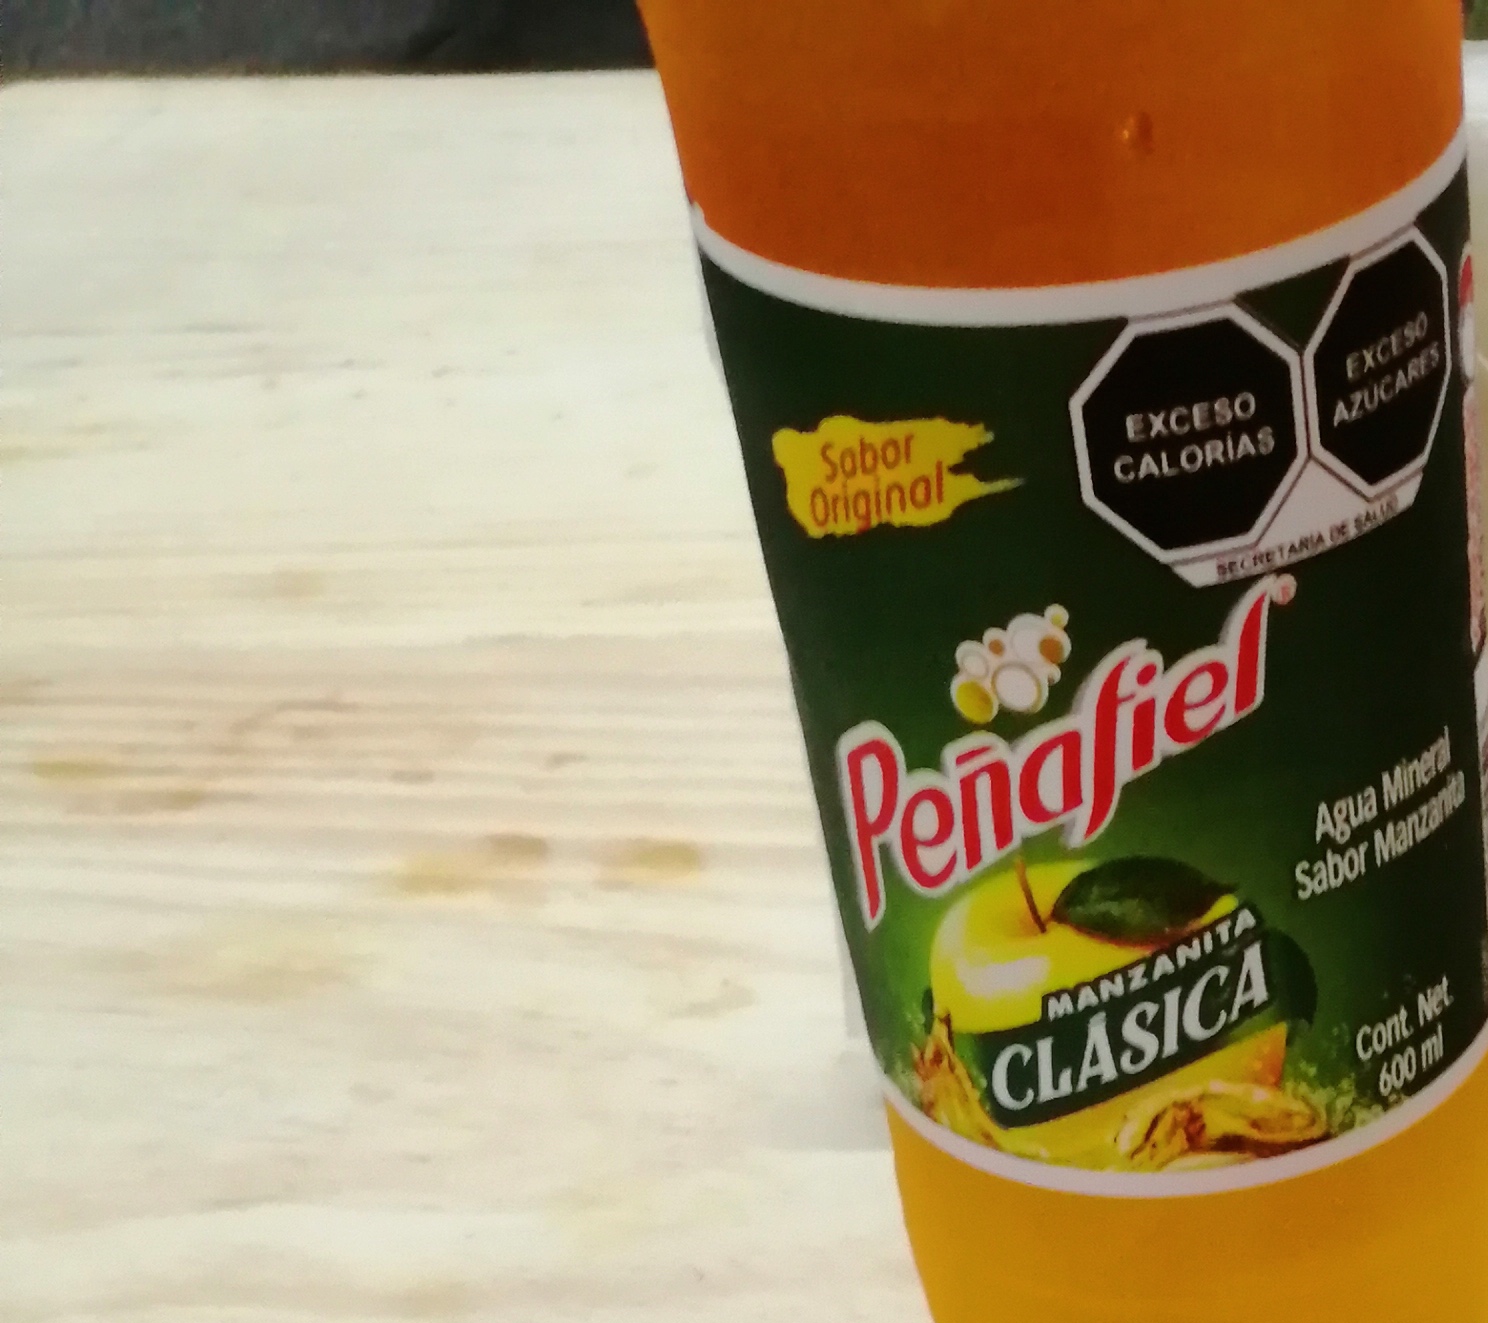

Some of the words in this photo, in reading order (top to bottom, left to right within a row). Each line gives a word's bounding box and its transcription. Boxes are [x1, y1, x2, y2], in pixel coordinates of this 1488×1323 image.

[1346, 311, 1428, 379] EXCESO
[1126, 391, 1257, 442] EXCESO
[820, 433, 914, 484] Sabor
[810, 459, 944, 534] Original
[840, 578, 1269, 926] Peñafiel
[1316, 785, 1378, 844] Agua
[1381, 724, 1450, 811] Mineral
[1295, 841, 1369, 900] Sabor
[1374, 769, 1465, 868] Manzanita
[1047, 908, 1257, 1022] MANZANITA
[1379, 1046, 1417, 1097] 600
[1421, 1022, 1443, 1072] ml
